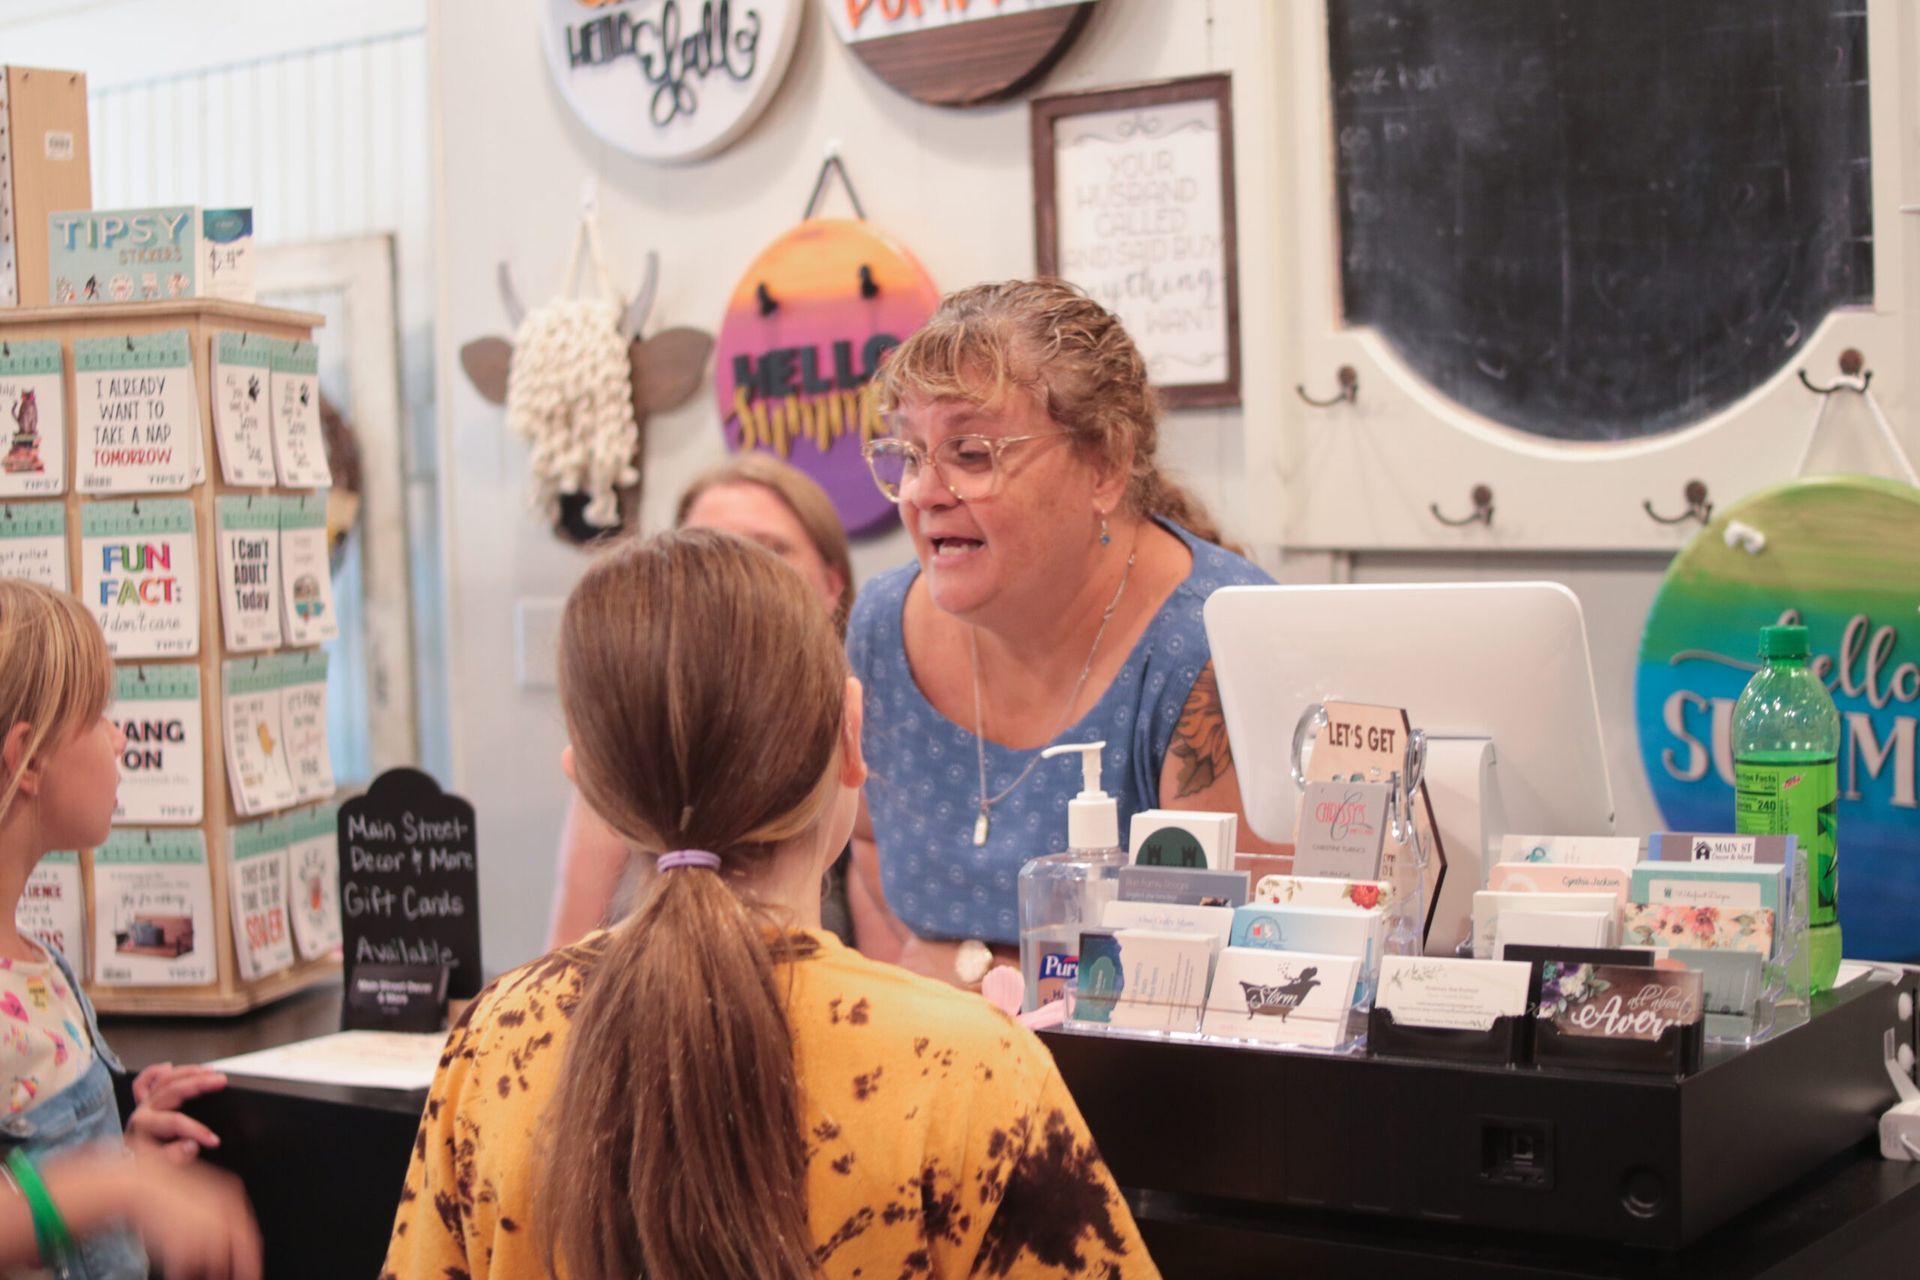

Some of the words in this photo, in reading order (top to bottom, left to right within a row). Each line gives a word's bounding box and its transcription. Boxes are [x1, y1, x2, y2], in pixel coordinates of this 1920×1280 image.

[1106, 150, 1173, 179] YOUR
[56, 212, 190, 252] TIPSY
[109, 375, 166, 399] ALREADY
[100, 402, 141, 421] WANT
[148, 402, 165, 419] TO
[94, 426, 124, 446] TAKE
[131, 427, 140, 445] A
[146, 425, 172, 445] NAP
[93, 447, 173, 468] TOMORROW
[101, 542, 171, 573] FUN
[234, 563, 269, 585] ADULT
[100, 576, 182, 607] FACT:
[117, 719, 186, 743] ANG
[1328, 721, 1363, 750] LET'S
[1368, 727, 1396, 754] GET
[123, 749, 163, 771] ON
[1757, 800, 1777, 812] 240
[348, 813, 397, 841] Main
[351, 846, 405, 873] Decor
[430, 848, 474, 873] More
[1714, 842, 1737, 854] MAIN
[344, 881, 397, 917] Gift
[402, 885, 464, 920] Cards
[356, 936, 459, 967] Available
